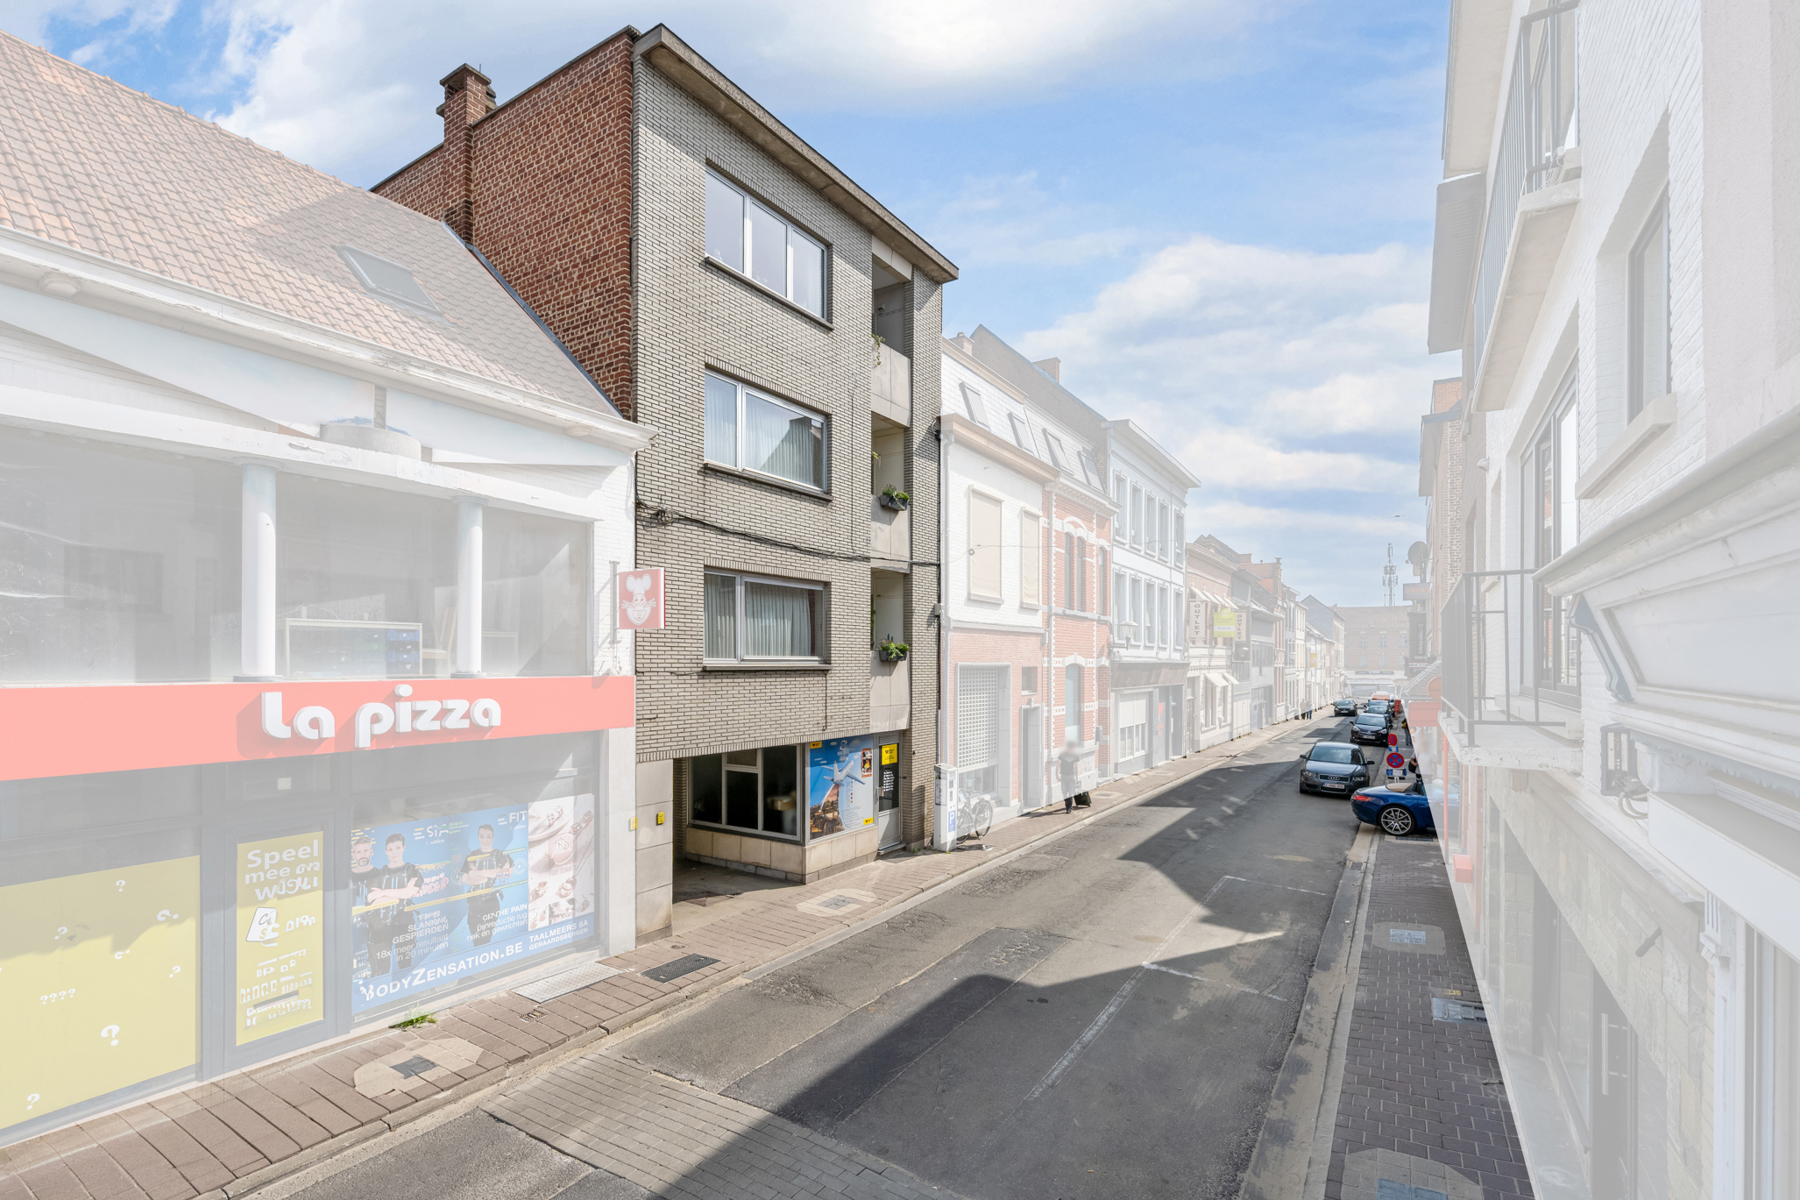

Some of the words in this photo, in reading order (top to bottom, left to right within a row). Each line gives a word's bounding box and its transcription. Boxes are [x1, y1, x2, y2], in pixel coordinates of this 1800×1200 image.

[261, 691, 335, 740] La
[354, 684, 501, 748] pizza
[247, 839, 319, 870] Speel
[245, 866, 291, 884] mee
[510, 903, 528, 914] PAIN
[467, 932, 480, 941] nek
[492, 919, 528, 936] gewrichten
[529, 923, 577, 944] TAALMEERS
[529, 928, 589, 950] GERAARDSBERGEN
[376, 950, 391, 960] 18x
[394, 944, 415, 955] meer
[416, 934, 449, 949] resultaat
[405, 949, 417, 960] 20
[418, 942, 449, 955] minuten
